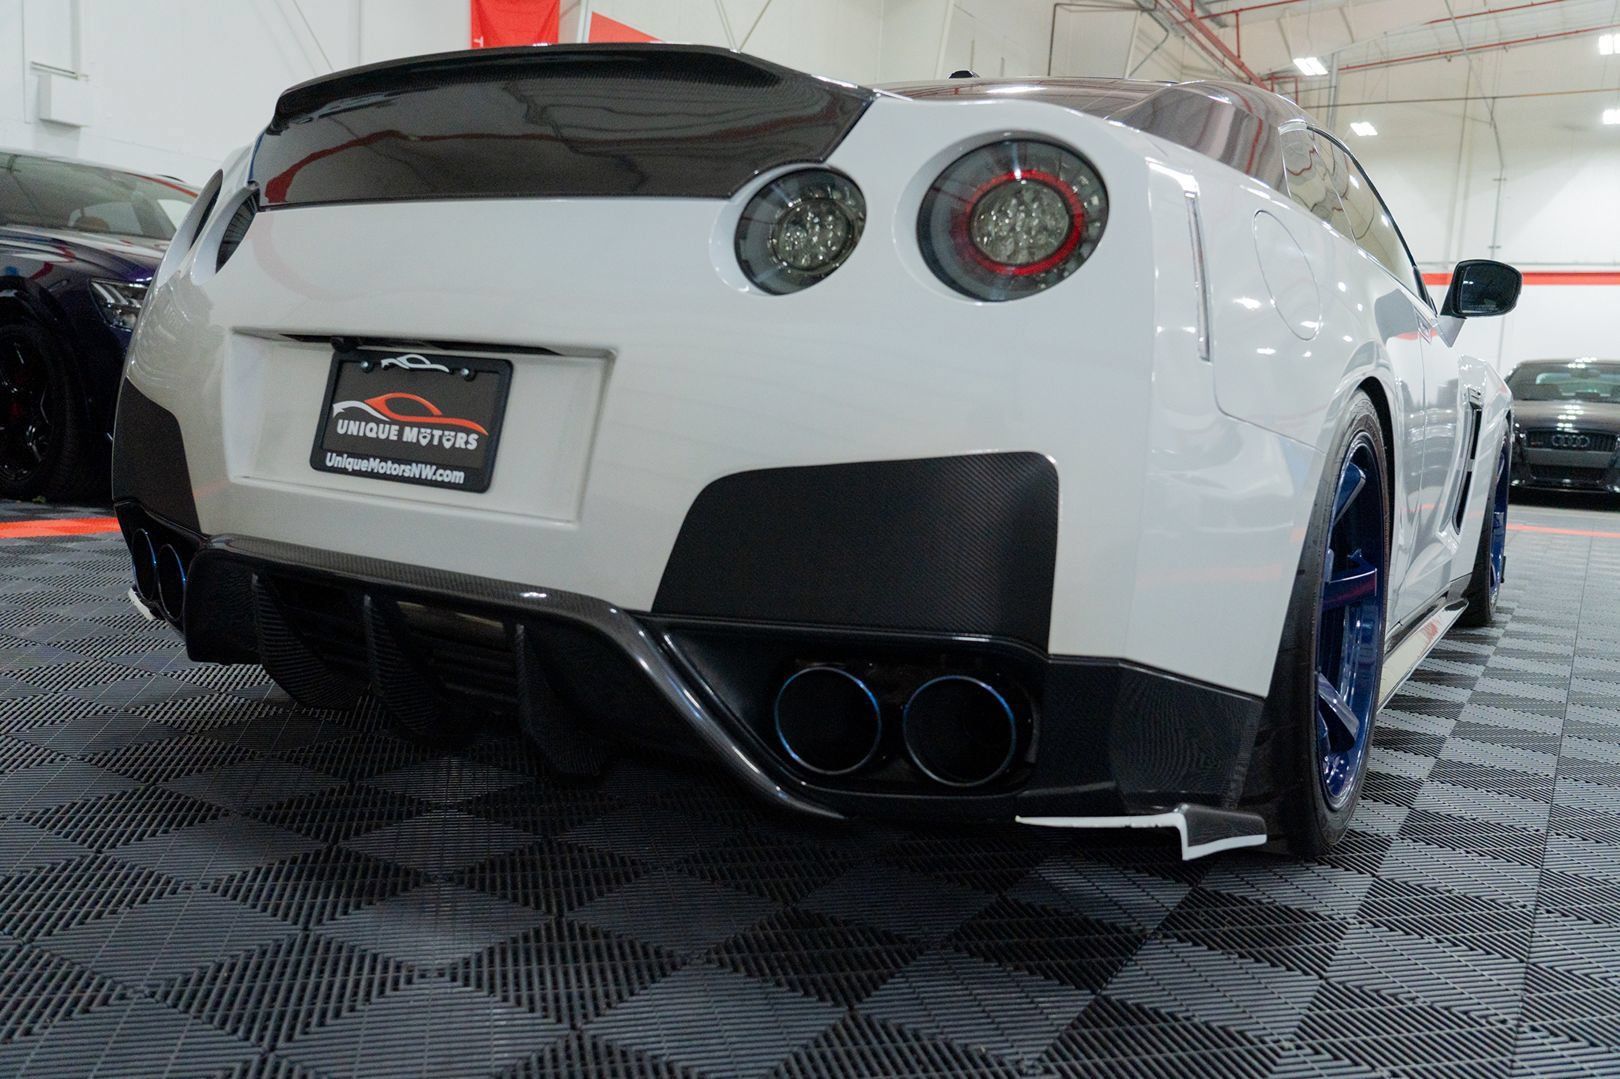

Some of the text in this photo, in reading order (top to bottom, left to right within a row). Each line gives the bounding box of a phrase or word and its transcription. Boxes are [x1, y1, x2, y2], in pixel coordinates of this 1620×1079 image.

[336, 419, 480, 450] UNIQUE MOTORS
[325, 452, 465, 484] UniqueMotorsNW.com
